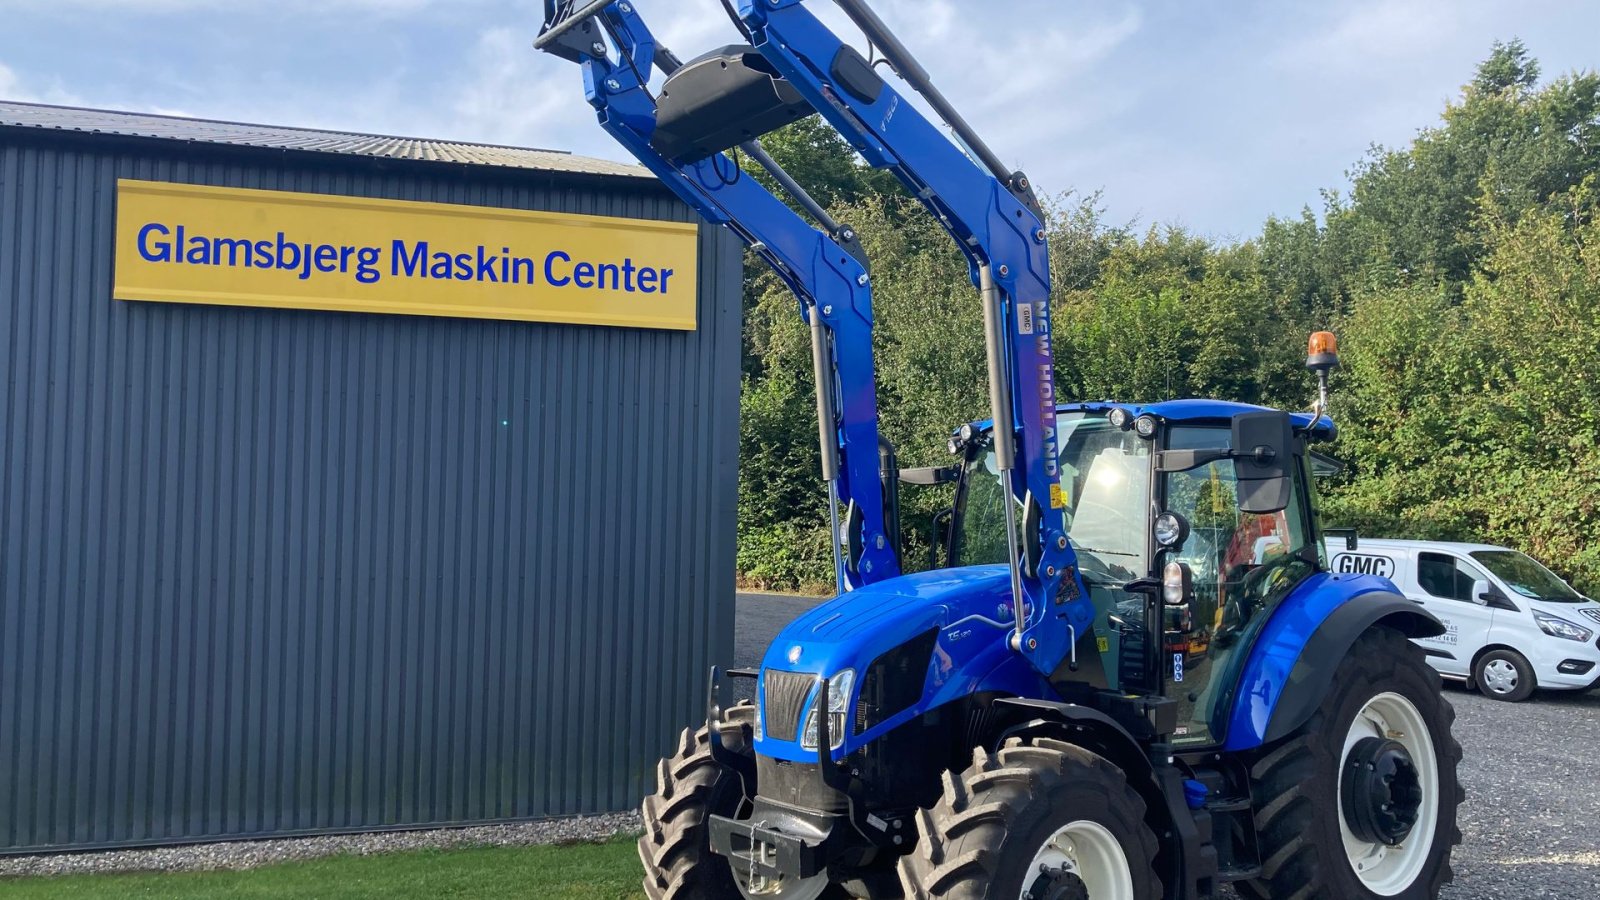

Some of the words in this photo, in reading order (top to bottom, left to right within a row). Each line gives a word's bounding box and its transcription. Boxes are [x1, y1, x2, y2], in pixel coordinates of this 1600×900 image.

[137, 223, 381, 283] Glamsbjerg
[391, 239, 534, 284] Maskin
[544, 250, 673, 293] Center
[1034, 301, 1050, 357] NEW
[1037, 364, 1057, 476] HOLLAND
[1339, 555, 1386, 576] GMC
